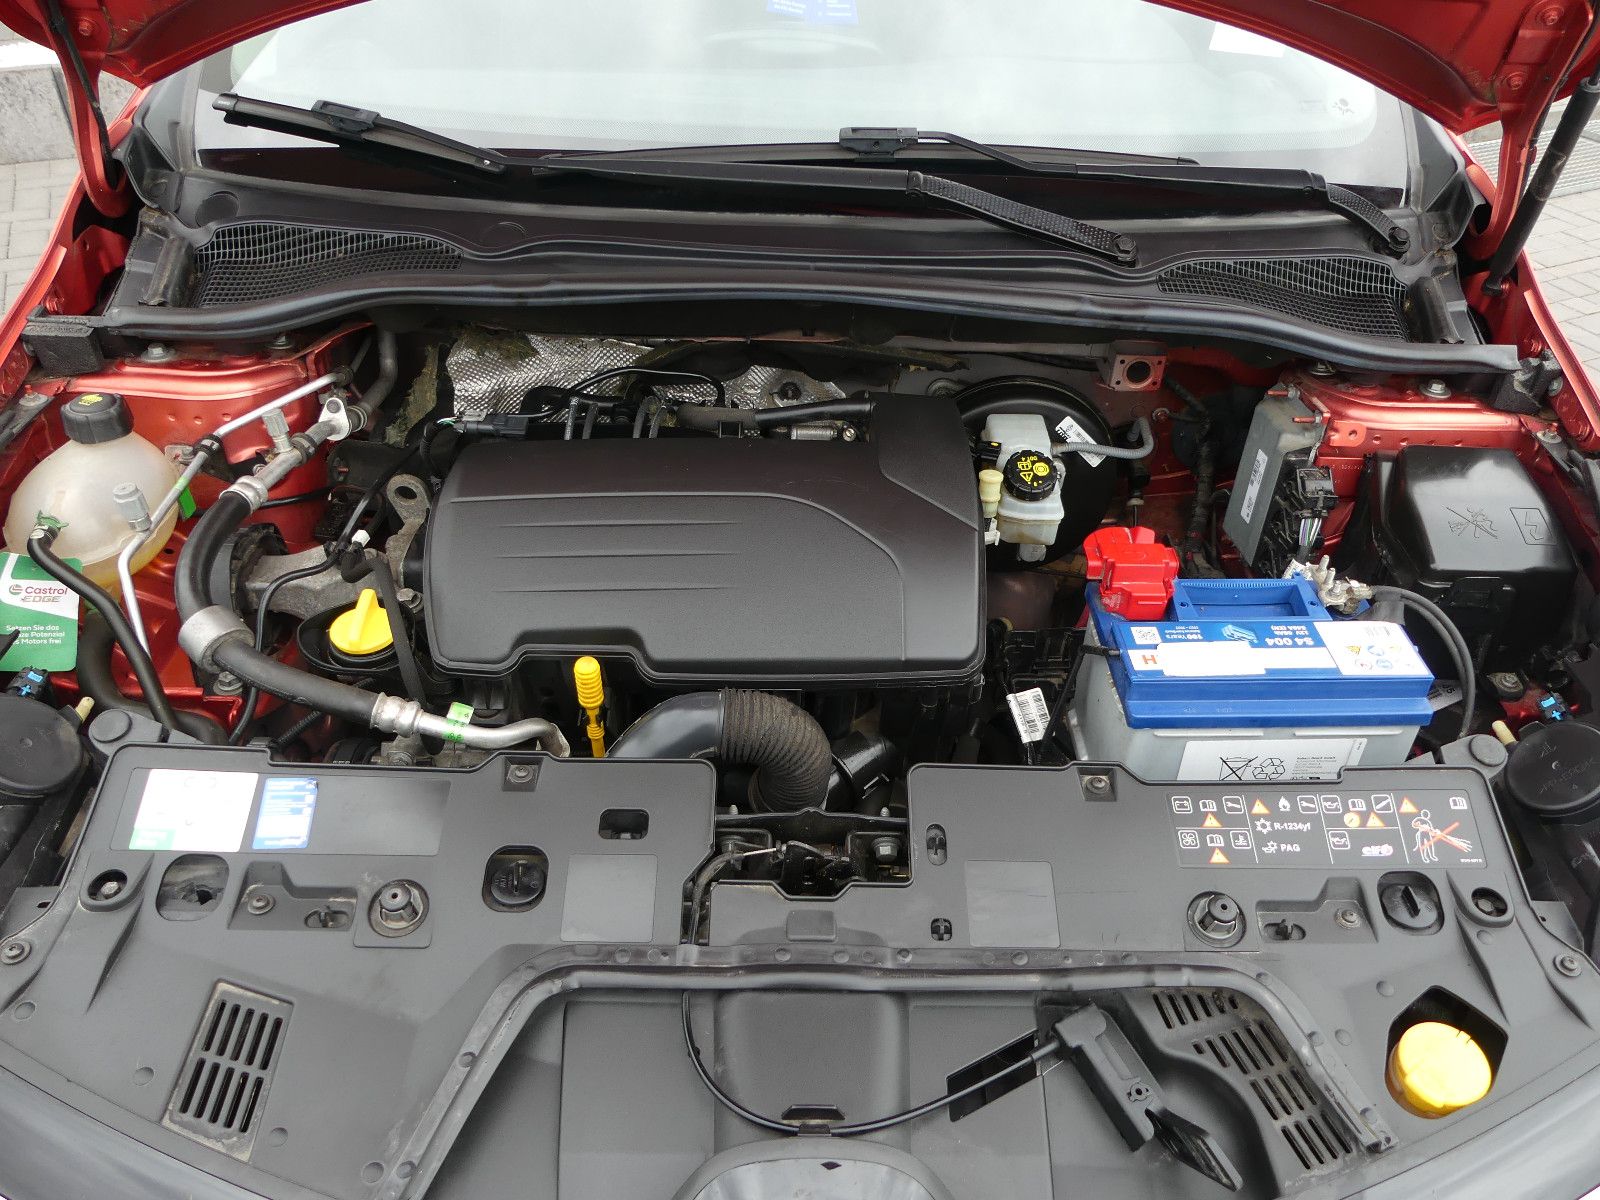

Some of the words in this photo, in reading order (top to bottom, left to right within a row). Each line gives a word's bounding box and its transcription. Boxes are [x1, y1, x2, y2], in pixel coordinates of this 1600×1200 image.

[25, 586, 68, 595] Castrol
[1273, 822, 1311, 832] R-1234yf
[1280, 843, 1300, 852] PAG
